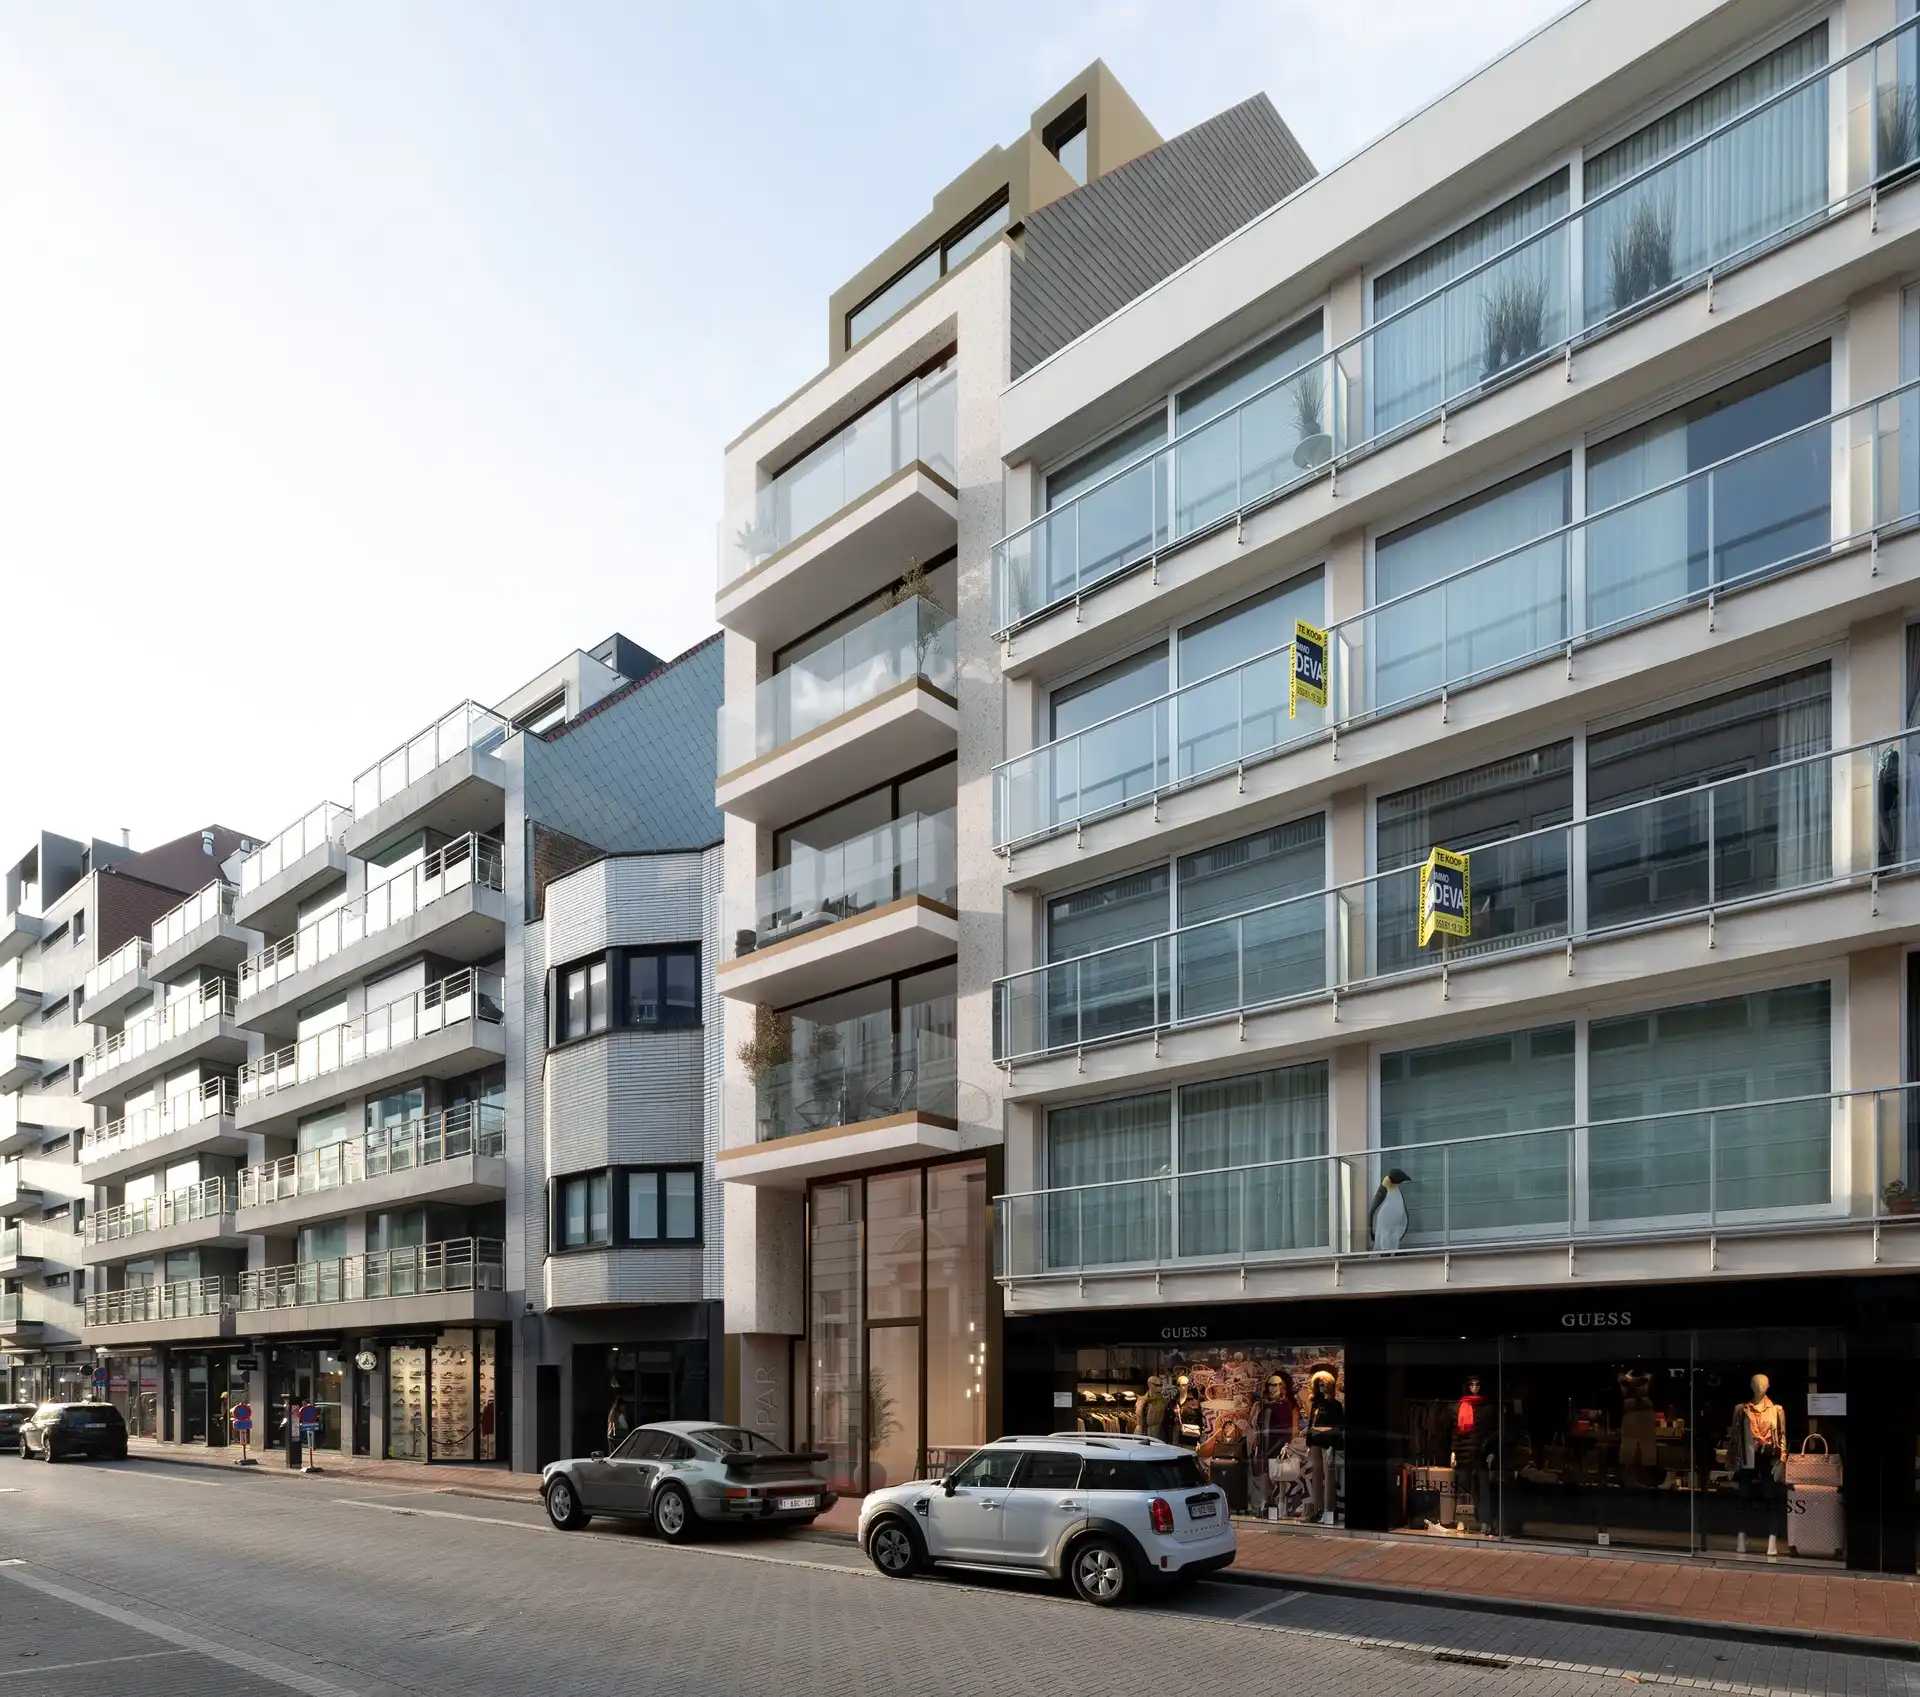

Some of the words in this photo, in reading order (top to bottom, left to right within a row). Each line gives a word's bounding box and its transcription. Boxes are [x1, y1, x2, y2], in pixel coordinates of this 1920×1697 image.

[1298, 624, 1306, 634] TE
[1307, 628, 1322, 641] KOOP
[1296, 651, 1324, 681] DEVA
[1436, 851, 1445, 862] TE
[1445, 854, 1463, 866] KOOP
[1434, 882, 1465, 911] DEVA
[1562, 1312, 1632, 1327] GUESS
[1161, 1326, 1207, 1339] GUESS
